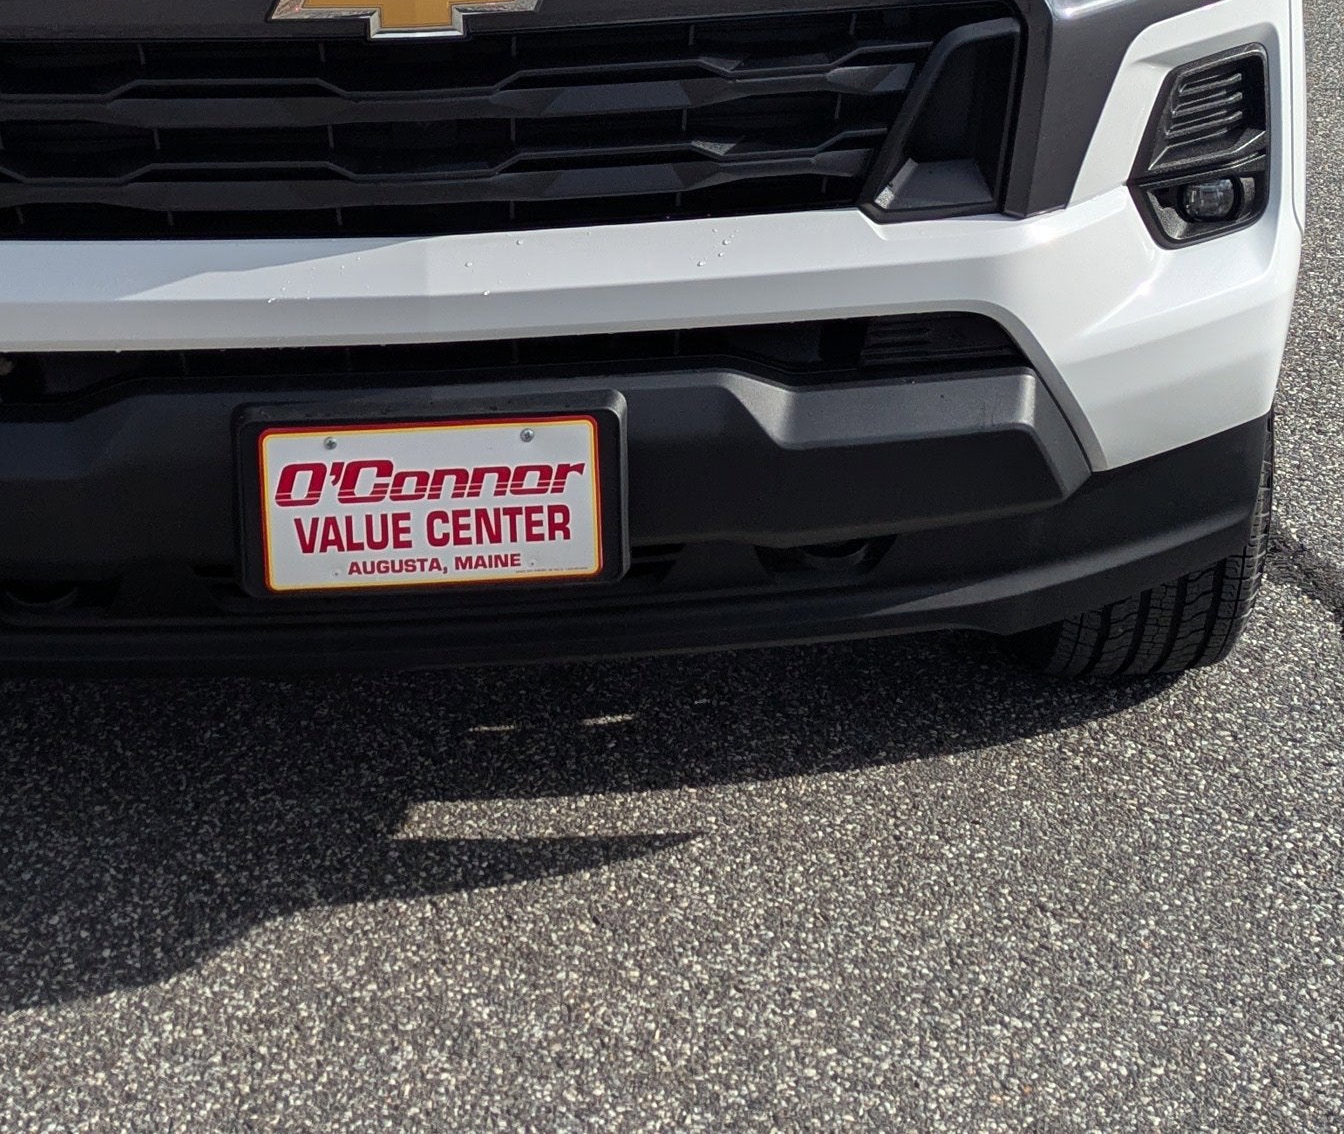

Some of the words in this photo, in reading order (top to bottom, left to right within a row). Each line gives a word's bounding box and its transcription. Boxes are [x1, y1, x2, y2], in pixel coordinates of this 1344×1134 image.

[274, 459, 585, 507] O'Connor
[294, 512, 412, 554] VALUE
[426, 504, 571, 546] CENTER
[347, 557, 448, 575] AUGUSTA,
[455, 553, 521, 570] MAINE
